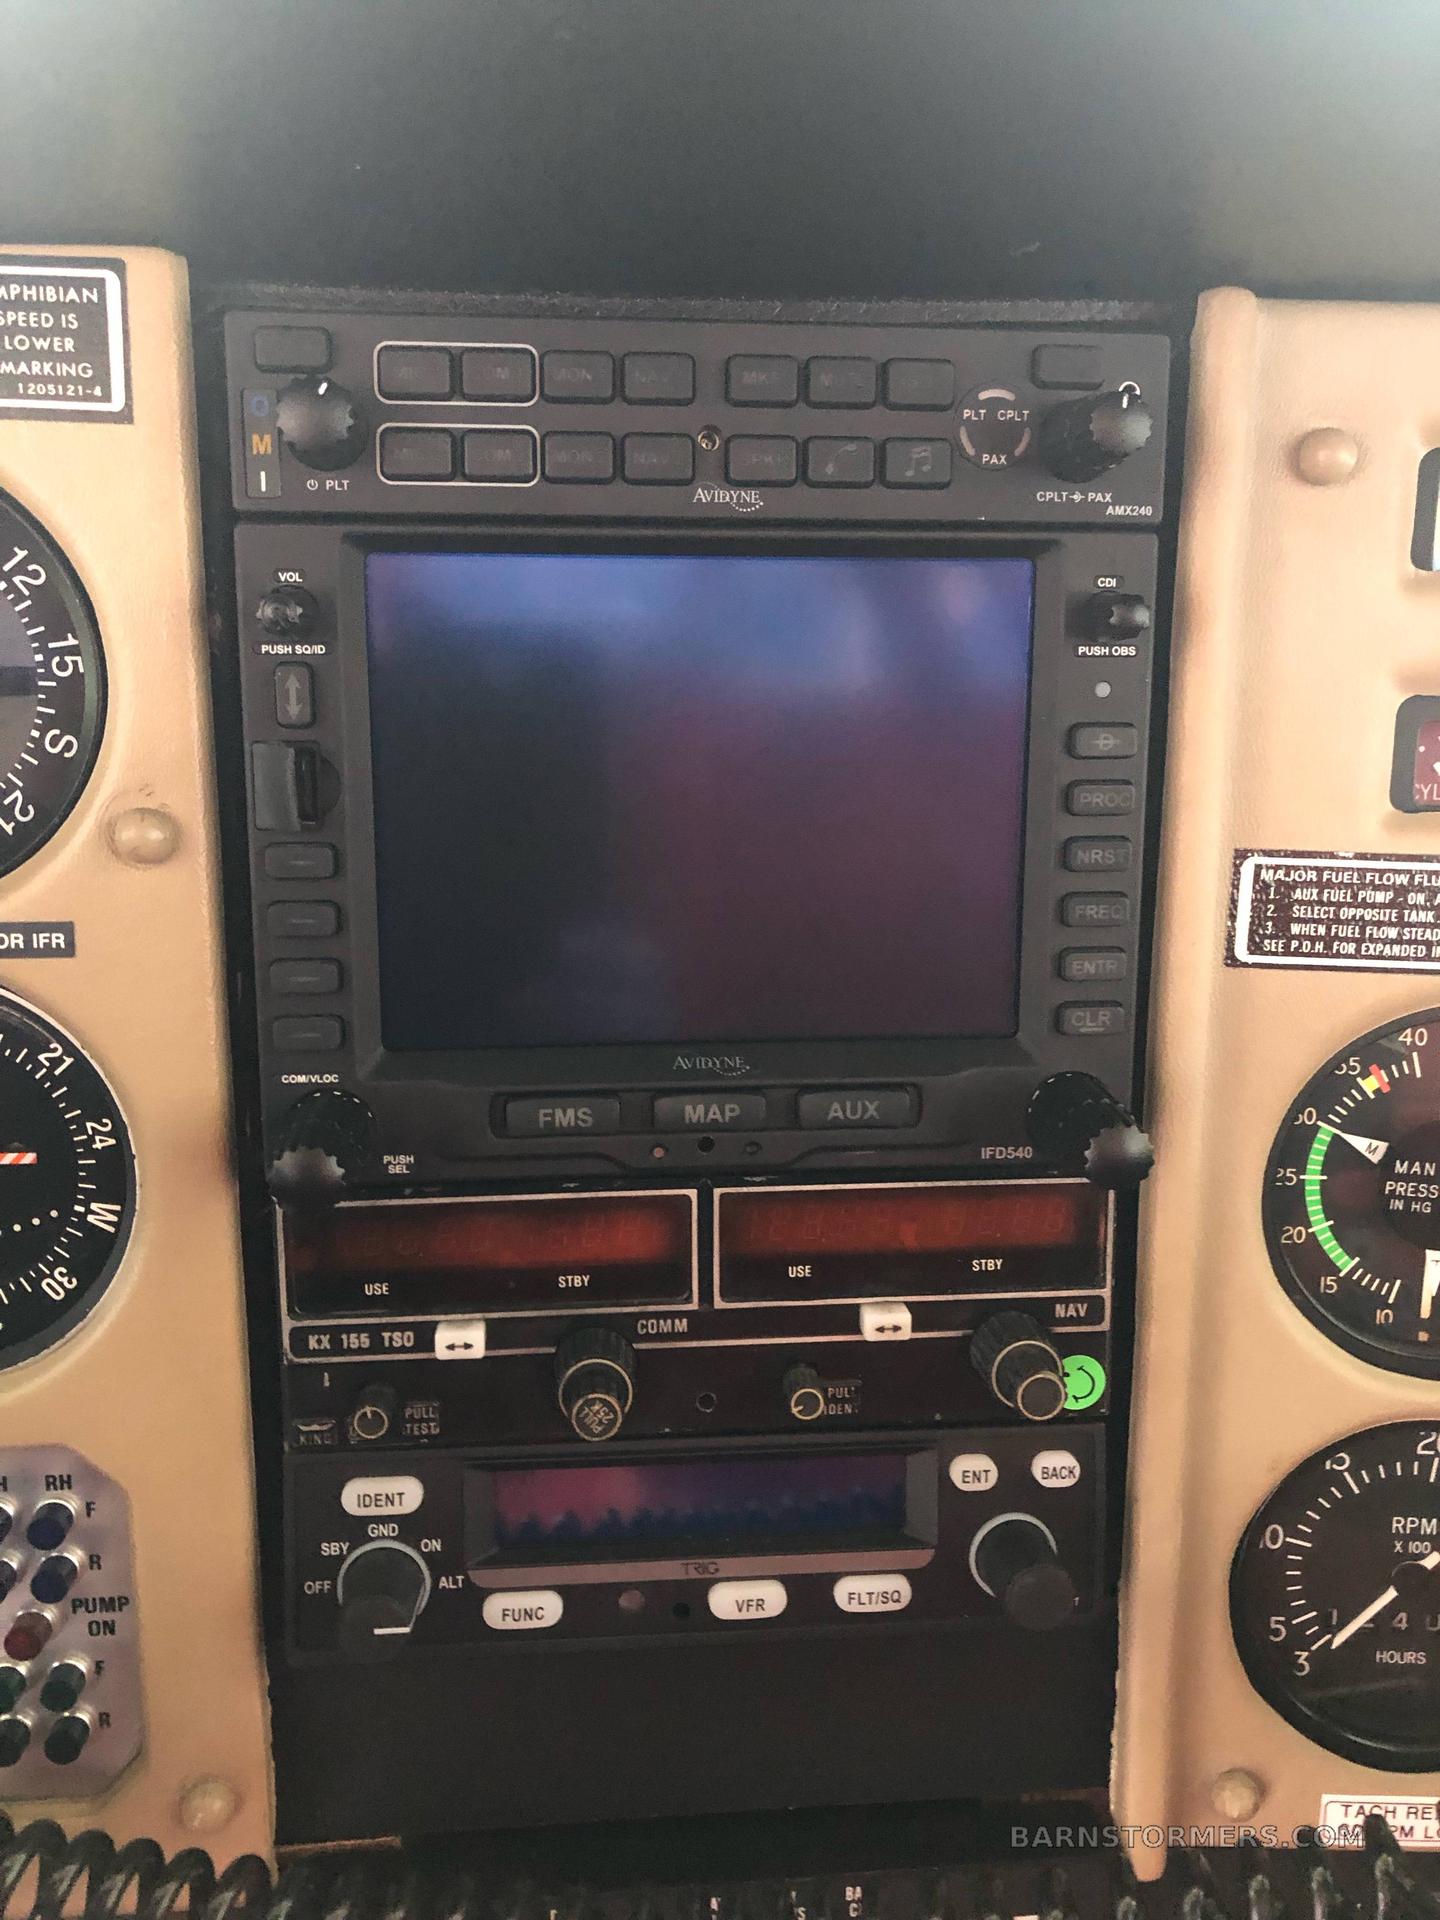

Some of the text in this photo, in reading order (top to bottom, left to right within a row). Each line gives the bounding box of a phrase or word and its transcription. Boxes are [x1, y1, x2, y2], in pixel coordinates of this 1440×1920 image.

[0, 312, 78, 329] SPEED IS
[4, 334, 75, 352] LOWER
[0, 360, 93, 378] MARKING
[18, 383, 102, 397] 1205121-4
[963, 409, 1029, 422] PLT CPLT
[252, 433, 272, 455] M
[982, 454, 1007, 465] PAX
[326, 479, 349, 491] PLT
[693, 487, 761, 503] AVIDYNE
[1036, 491, 1113, 503] CPLT PAX
[1105, 506, 1153, 517] AMX240
[2, 546, 47, 597] 12
[278, 571, 303, 582] VOL
[1097, 577, 1117, 588] CDI
[47, 632, 85, 678] 15
[261, 644, 326, 655] PUSH SQ/ID
[1078, 645, 1137, 656] PUSH OBS
[44, 728, 78, 758] S
[1260, 868, 1317, 882] MAJOR
[1322, 870, 1361, 884] FUEL
[1365, 872, 1411, 886] FLOW
[1292, 888, 1319, 901] AUX
[1322, 889, 1353, 902] FUEL
[1357, 890, 1394, 903] PUMP
[1292, 905, 1336, 919] SELECT
[1339, 907, 1399, 921] OPPOSITE
[1290, 922, 1326, 936] WHEN
[1330, 924, 1361, 938] FUEL
[1365, 925, 1400, 940] FLOW
[32, 933, 65, 949] IFR
[1263, 939, 1285, 952] SEE
[1290, 940, 1327, 954] P.O.H.
[1332, 941, 1357, 955] FOR
[1361, 943, 1426, 958] EXPANDED
[1071, 960, 1118, 975] ENTR
[1070, 1011, 1112, 1028] CLR
[1398, 1027, 1428, 1046] 40
[37, 1041, 75, 1077] 21
[281, 1073, 339, 1084] COM/VLOC
[538, 1107, 594, 1128] FMS
[684, 1103, 742, 1124] MAP
[827, 1100, 881, 1120] AUX
[85, 1118, 117, 1151] 24
[383, 1154, 415, 1166] PUSH
[981, 1146, 1033, 1160] IFD540
[388, 1165, 411, 1175] SEL
[1394, 1159, 1436, 1176] MAN
[1384, 1181, 1440, 1198] PRESS
[1389, 1199, 1433, 1214] IN HG
[86, 1202, 122, 1233] W
[1281, 1225, 1307, 1244] 20
[788, 1265, 812, 1278] USE
[971, 1258, 1004, 1272] STBY
[40, 1266, 78, 1301] 30
[364, 1282, 390, 1296] USE
[558, 1274, 591, 1288] STBY
[1319, 1275, 1338, 1294] 15
[1054, 1302, 1088, 1319] NAV
[637, 1317, 689, 1335] COMM
[308, 1333, 331, 1350] KX
[340, 1332, 370, 1349] 155
[404, 1406, 436, 1419] PULL
[406, 1423, 437, 1436] TEST
[962, 1469, 991, 1484] ENT
[1041, 1465, 1077, 1480] BACK
[45, 1474, 72, 1491] RH
[357, 1491, 406, 1508] IDENT
[85, 1501, 96, 1517] F
[367, 1522, 399, 1537] GND
[1391, 1516, 1438, 1536] RPM
[320, 1541, 350, 1556] SBY
[420, 1538, 442, 1552] ON
[1394, 1541, 1432, 1554] X 100
[88, 1554, 102, 1570] R
[680, 1561, 720, 1576] TRIG
[304, 1580, 332, 1595] OFF
[438, 1574, 466, 1589] ALT
[71, 1595, 130, 1614] PUMP
[735, 1597, 766, 1613] VFR
[848, 1590, 902, 1606] FLT/SQ
[501, 1605, 546, 1622] FUNC
[87, 1619, 117, 1637] ON
[1268, 1616, 1287, 1642] 5
[1293, 1650, 1311, 1676] 3
[1375, 1650, 1427, 1665] HOURS
[94, 1659, 105, 1676] F
[98, 1711, 112, 1728] R
